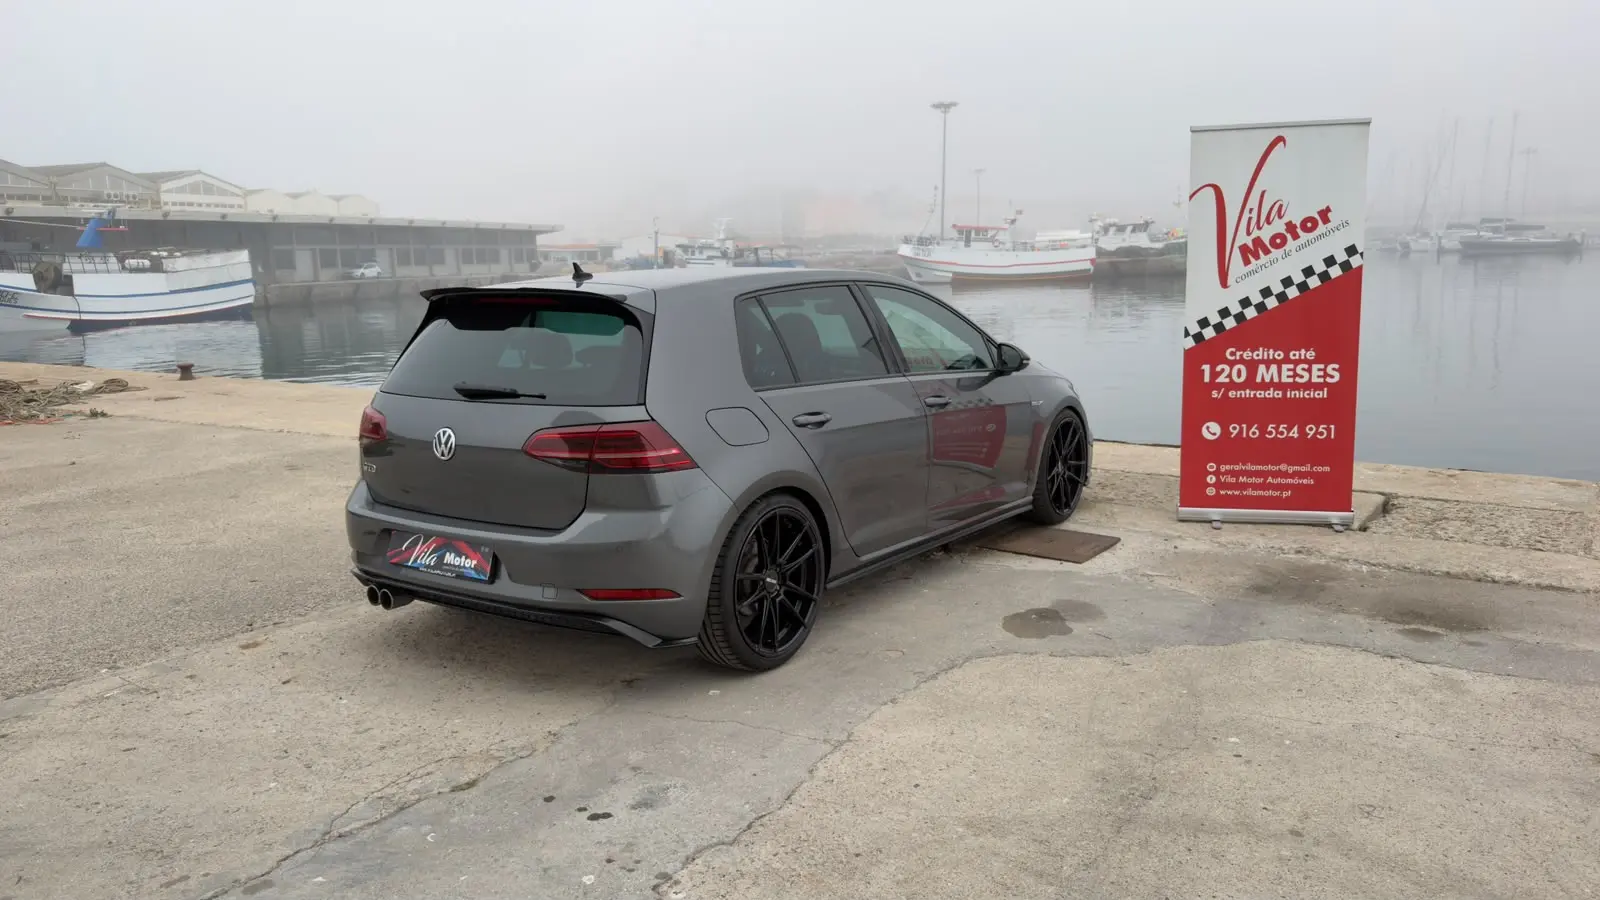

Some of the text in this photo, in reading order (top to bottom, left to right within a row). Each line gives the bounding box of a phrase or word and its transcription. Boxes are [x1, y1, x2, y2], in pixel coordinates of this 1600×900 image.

[1189, 135, 1289, 289] Vila
[1238, 205, 1332, 267] Motor
[1235, 219, 1350, 284] comércio de automóveis
[1225, 347, 1316, 360] Crédito até
[1200, 363, 1341, 383] 120 MESES
[1211, 387, 1328, 399] s/ entrada inicial
[1229, 423, 1336, 439] 916 554 951
[1219, 462, 1331, 474] geralvilamotor@gmail.com
[1219, 474, 1315, 485] Vila Motor Automóveis
[1219, 487, 1292, 499] www.vilamotor.pt
[402, 533, 478, 568] Vila Motor
